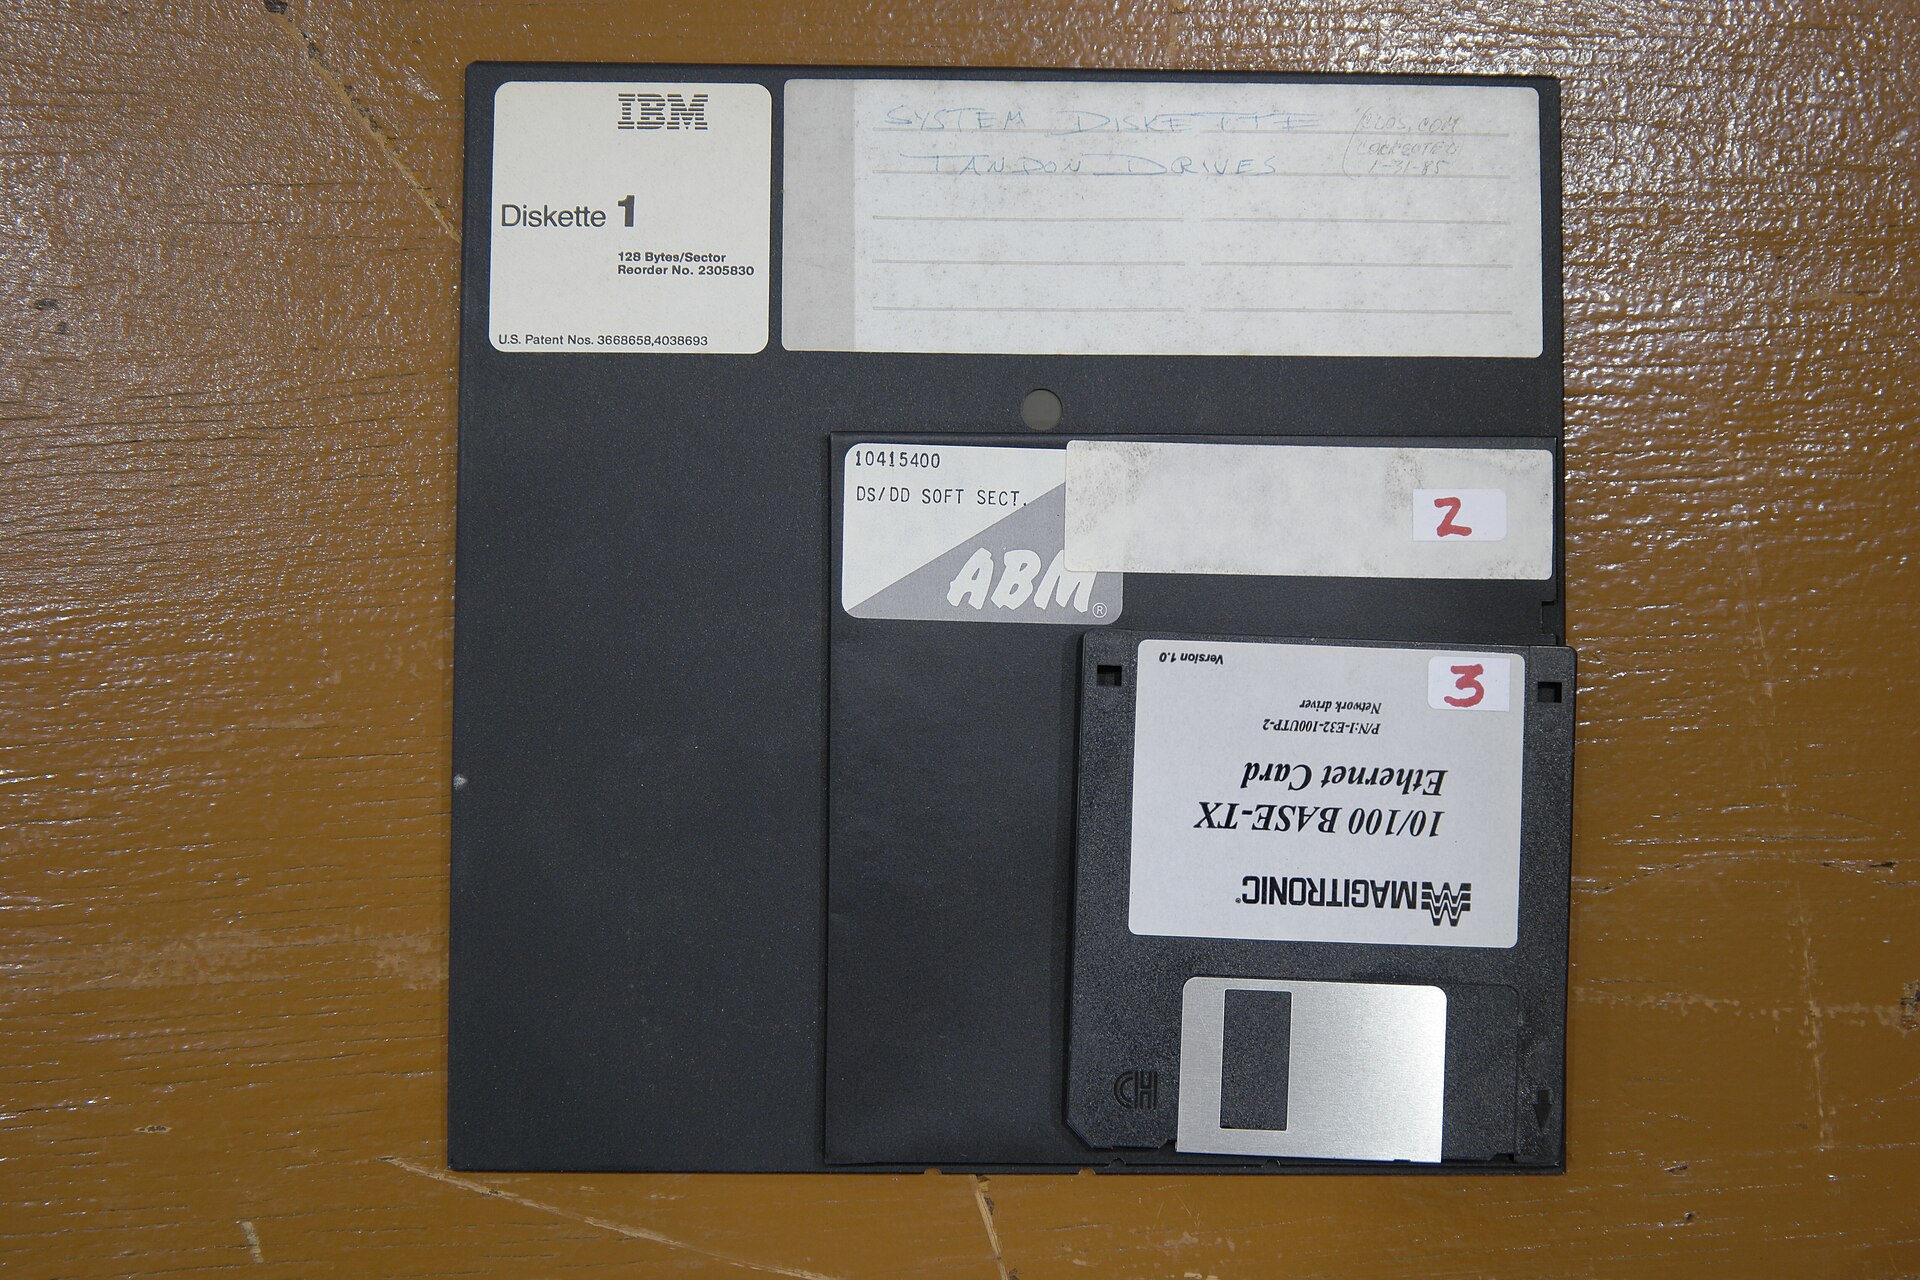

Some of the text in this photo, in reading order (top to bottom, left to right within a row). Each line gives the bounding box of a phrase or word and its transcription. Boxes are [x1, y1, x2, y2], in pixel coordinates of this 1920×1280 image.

[617, 93, 709, 131] IBM
[884, 104, 1323, 135] SYSTEM DISKETTE
[899, 152, 1278, 176] TANDON DRIVES
[501, 194, 635, 228] Diskette 1
[617, 251, 727, 264] 128 Bytes/Sector
[617, 264, 755, 276] Reorder No. 2305830
[498, 334, 708, 347] U.S. Patent Nos. 3668658,4038693
[855, 450, 941, 469] 10415400
[856, 485, 1029, 507] DS/DD SOFT SECT.
[946, 547, 1098, 613] ABM
[1158, 651, 1224, 665] Version 1.0
[1443, 663, 1486, 708] 3
[1298, 699, 1382, 715] Network driver
[1239, 761, 1449, 797] Ethernet Card
[1192, 801, 1445, 838] 10/100 BASE-TX
